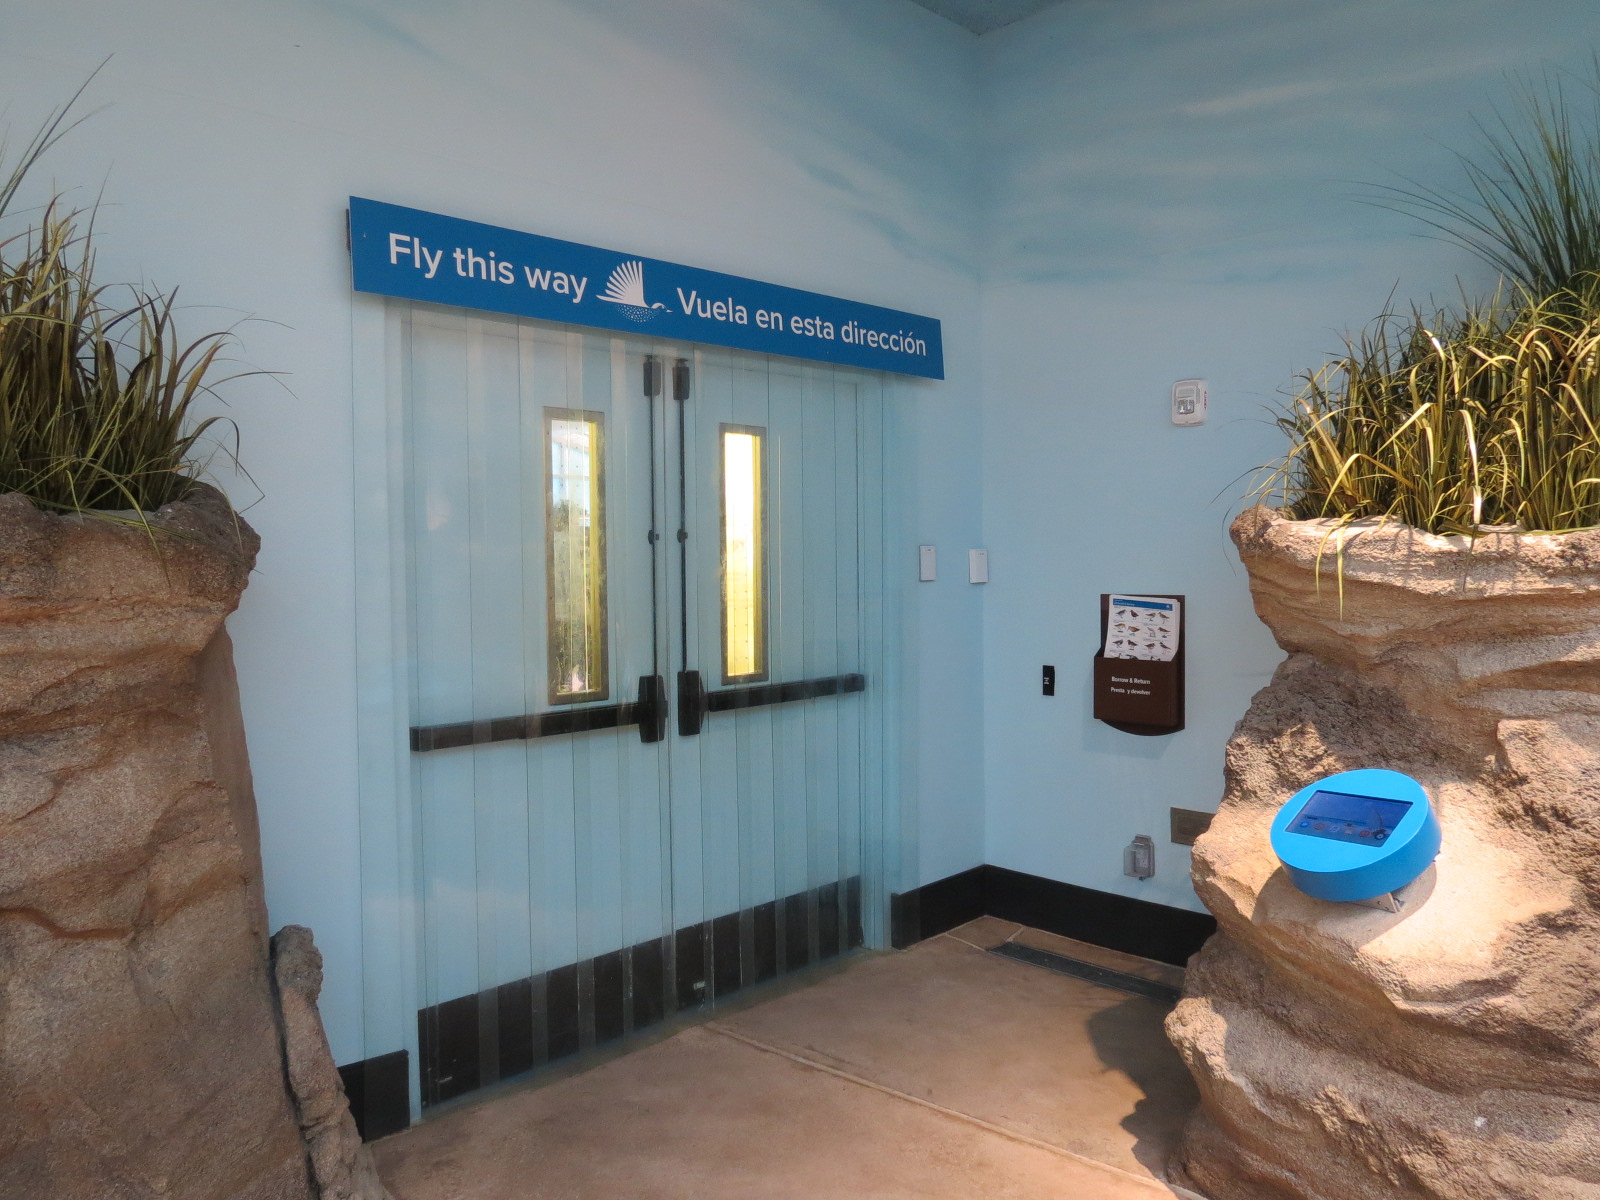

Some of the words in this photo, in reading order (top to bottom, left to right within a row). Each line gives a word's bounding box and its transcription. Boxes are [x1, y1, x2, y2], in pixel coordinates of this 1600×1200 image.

[389, 232, 443, 279] Fly
[453, 247, 515, 285] this
[524, 265, 588, 304] way
[677, 287, 748, 326] Vuela
[755, 308, 783, 331] en
[790, 315, 835, 341] esta
[841, 320, 927, 357] dirección
